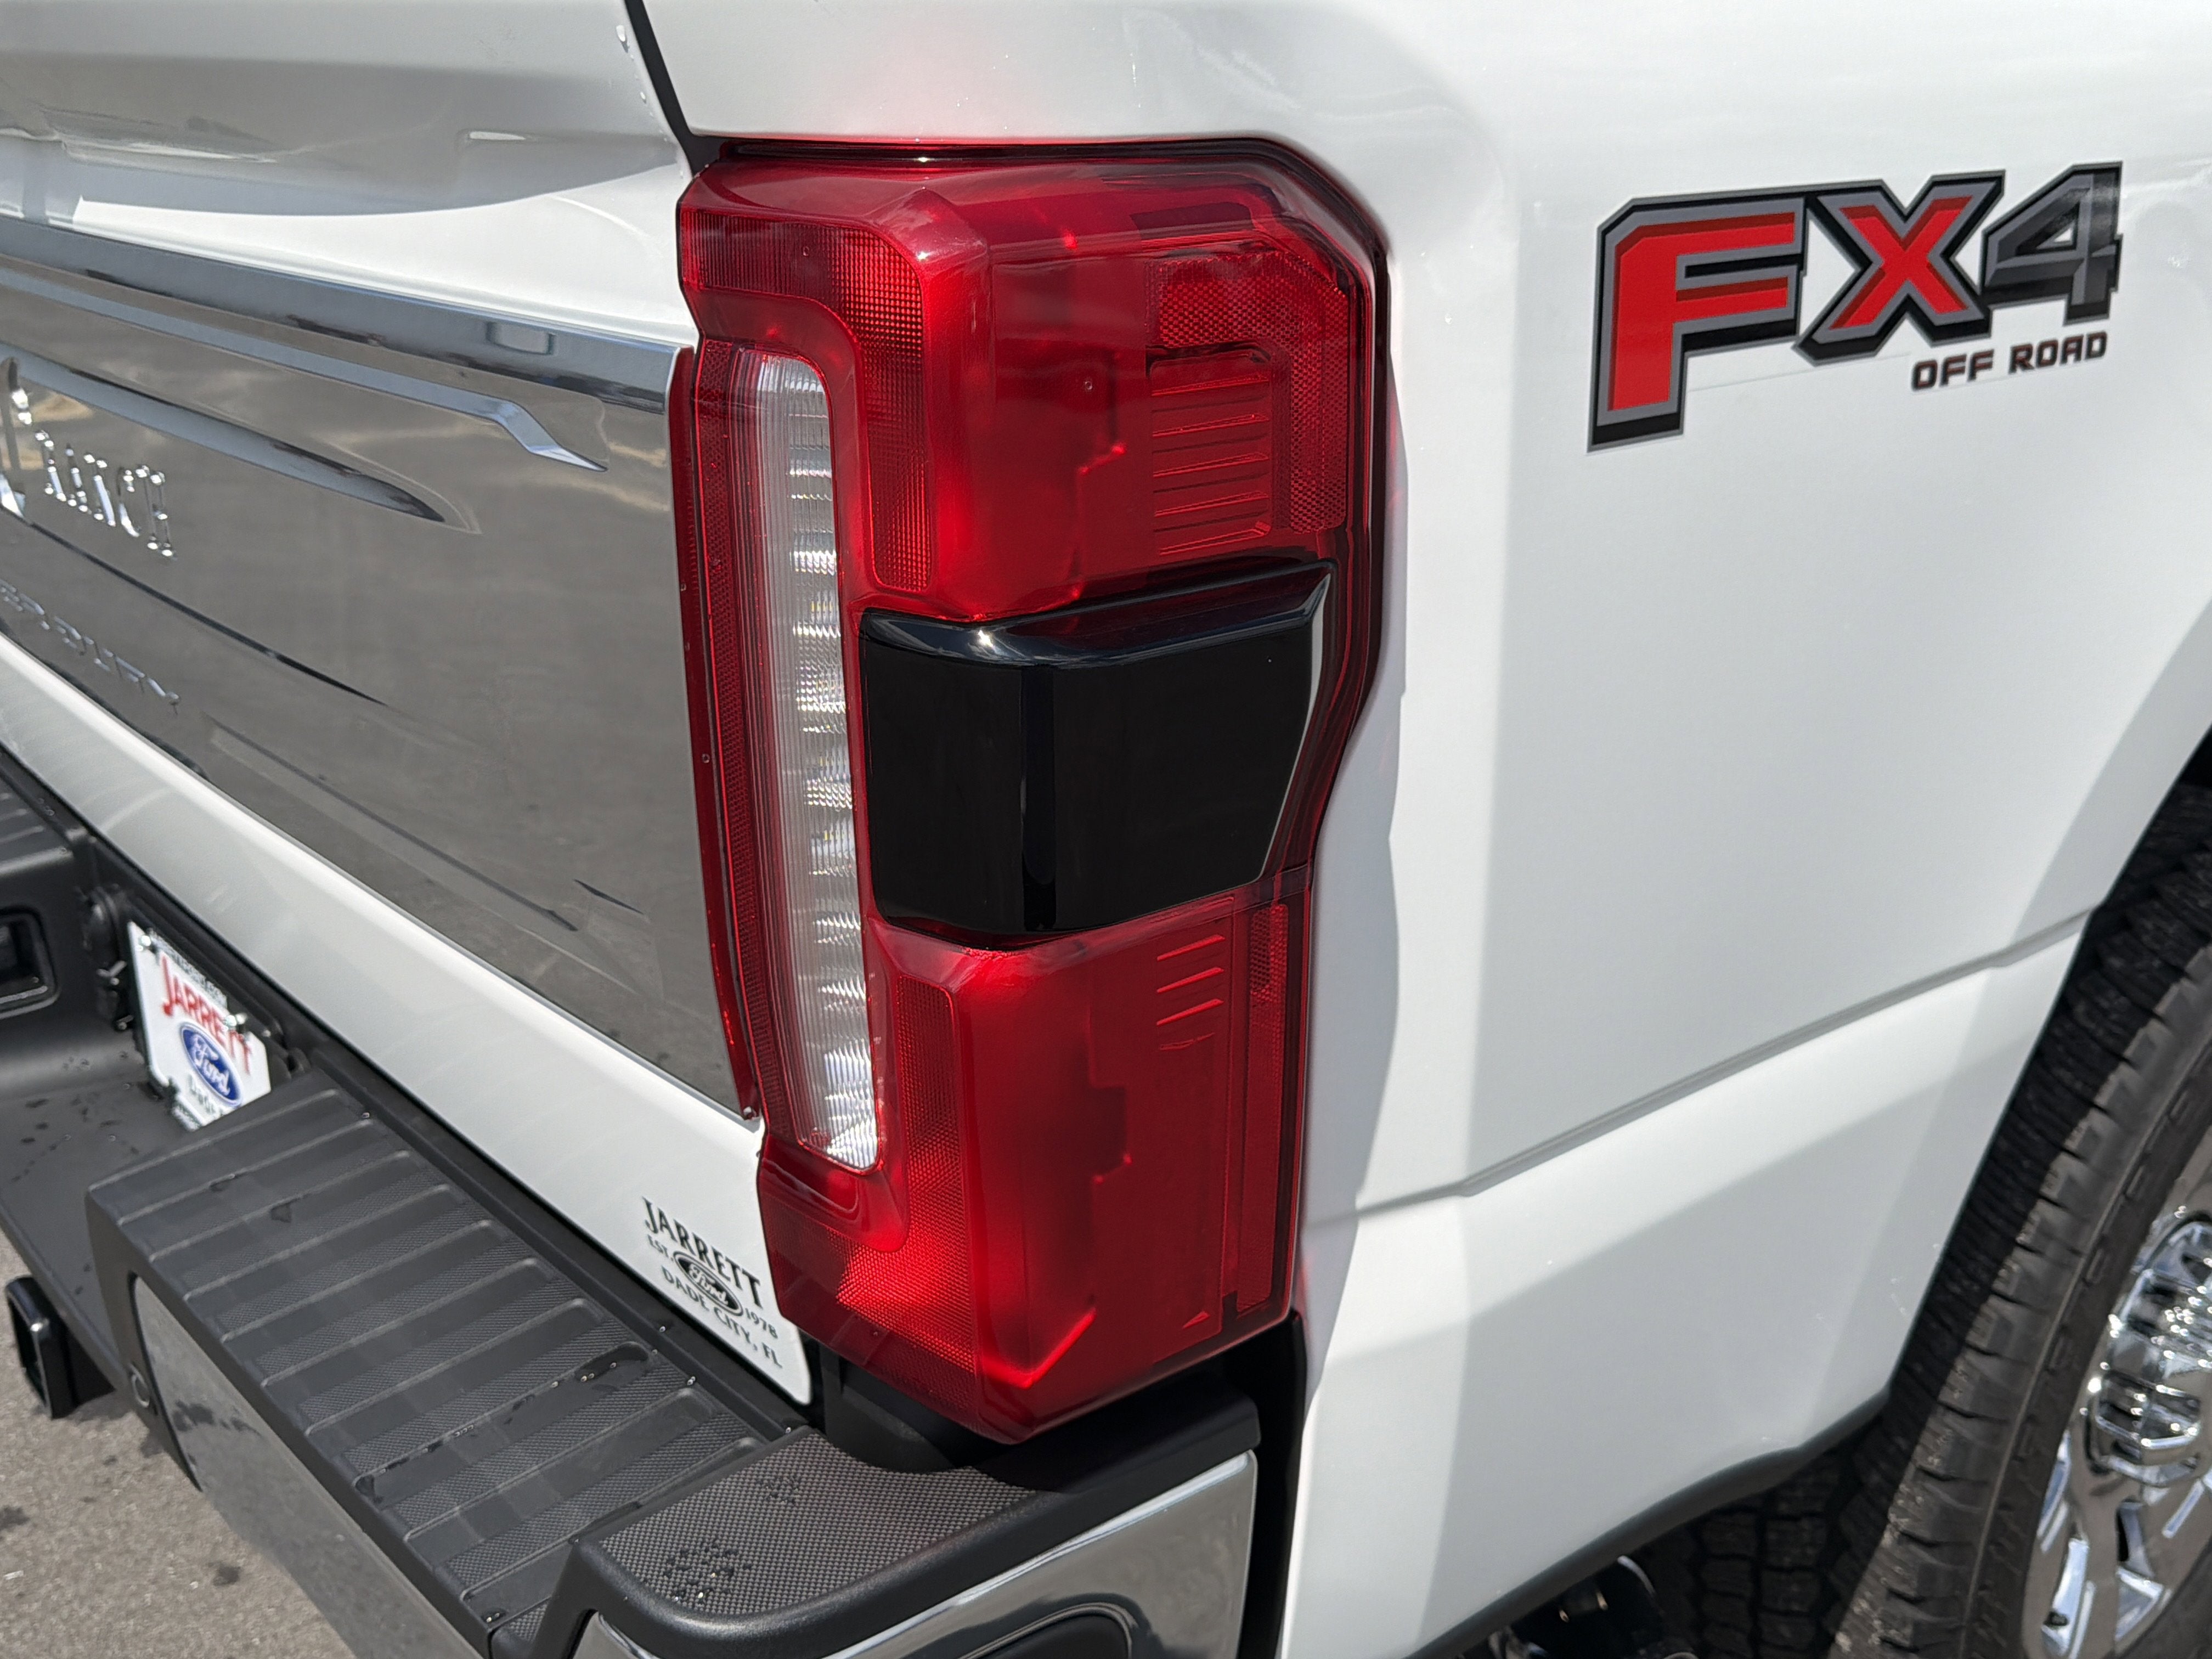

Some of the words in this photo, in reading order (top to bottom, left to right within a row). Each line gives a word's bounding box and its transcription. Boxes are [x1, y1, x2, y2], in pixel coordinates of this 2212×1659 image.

[1587, 161, 2122, 453] FX4
[1910, 350, 1994, 392] OFF
[2008, 331, 2108, 375] ROAD
[162, 956, 252, 1075] JARRETT
[642, 1196, 763, 1309] JARRETT
[661, 1265, 710, 1312] DADE
[714, 1307, 758, 1351] CITY,
[762, 1342, 783, 1368] FL
[744, 1308, 778, 1339] 1978
